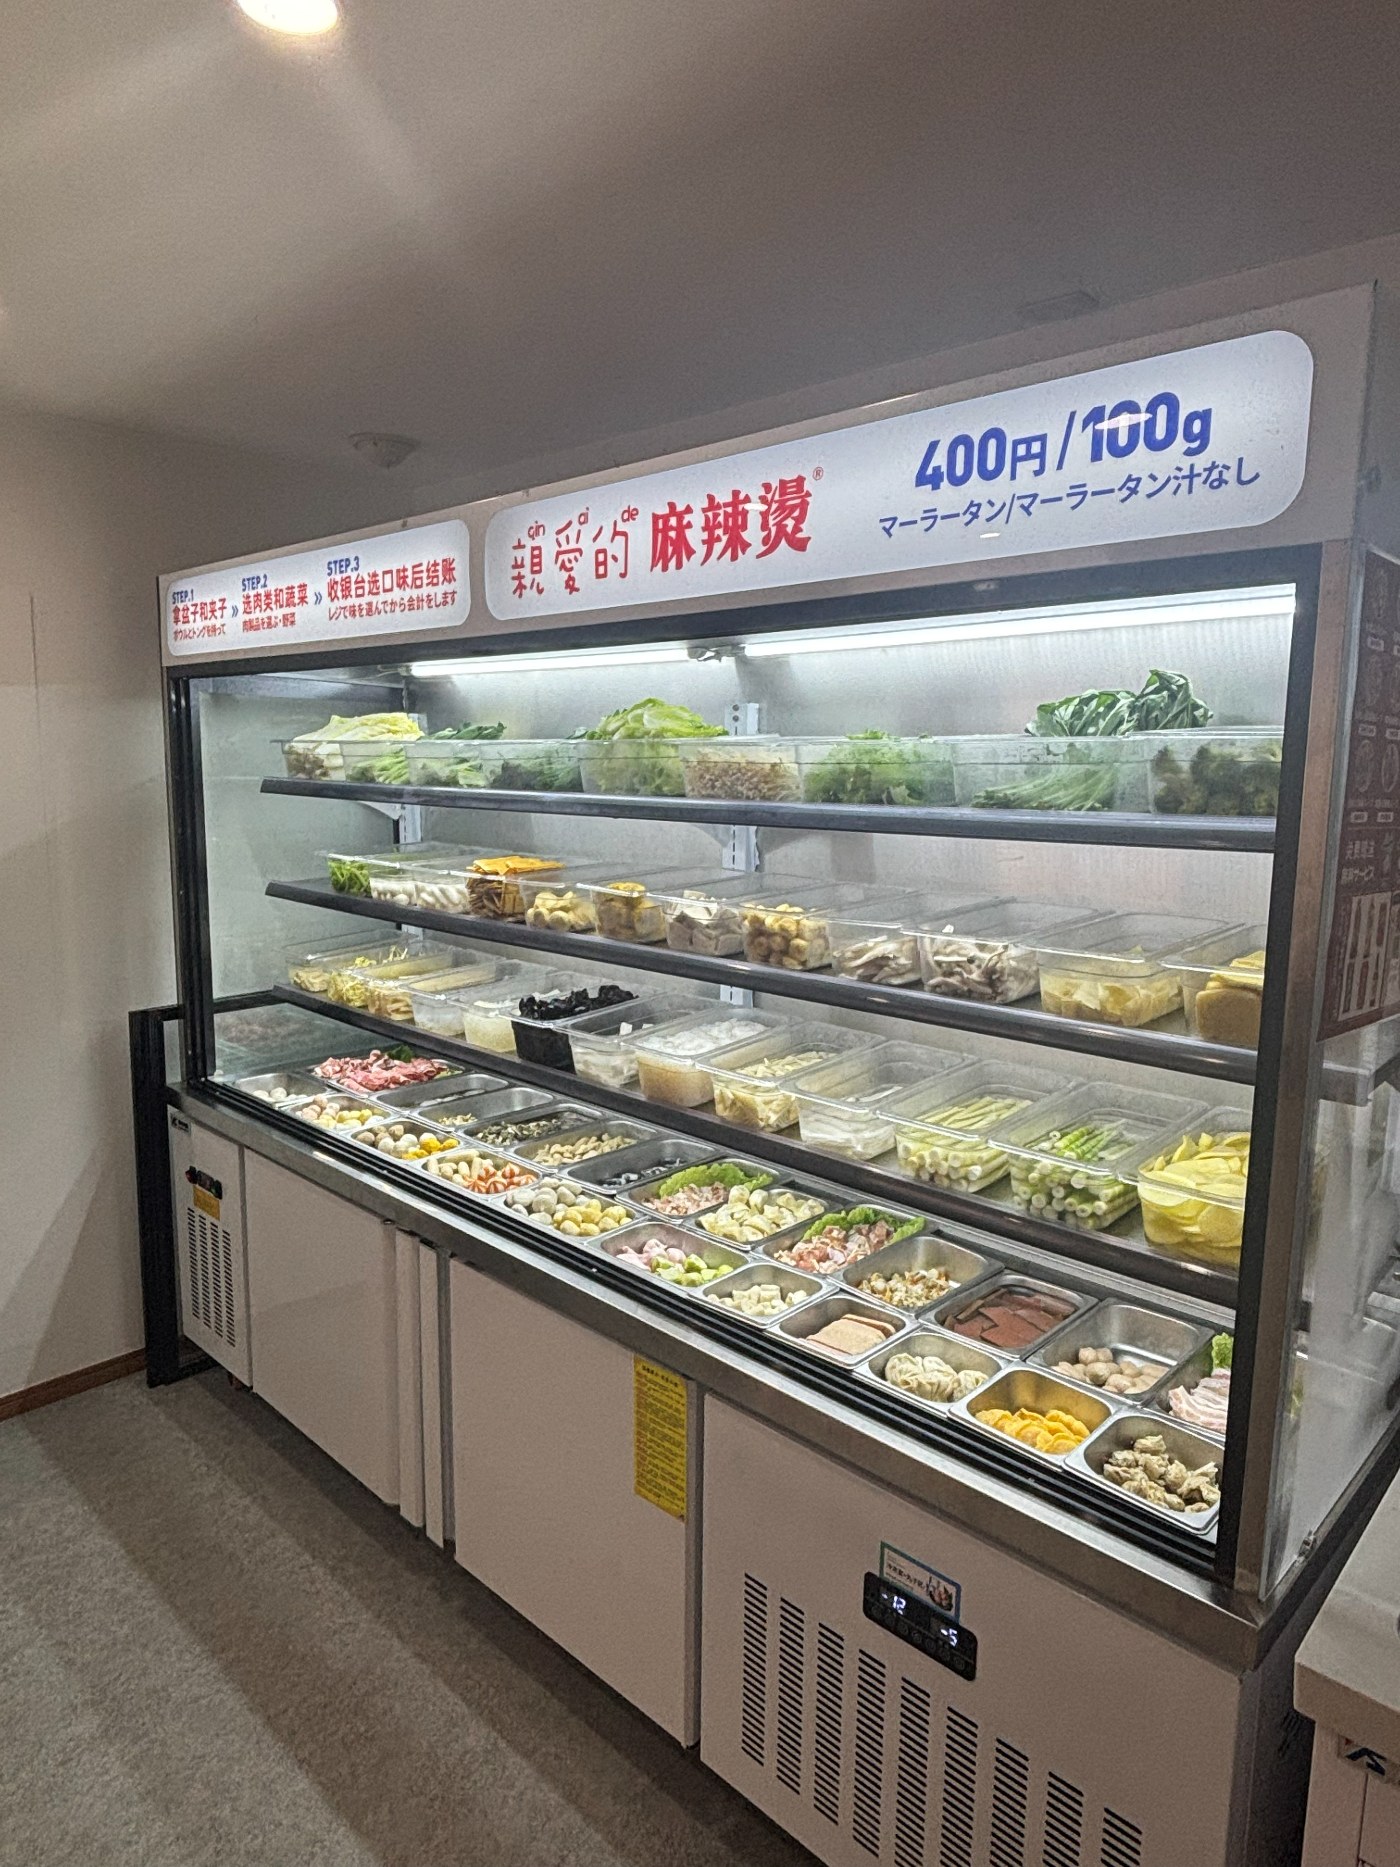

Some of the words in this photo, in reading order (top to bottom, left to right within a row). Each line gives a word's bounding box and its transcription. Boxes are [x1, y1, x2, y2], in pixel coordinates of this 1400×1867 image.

[621, 505, 639, 524] de
[327, 556, 360, 576] STEP.3
[241, 574, 268, 592] STEP.2
[327, 557, 457, 603] 收银台选口味后结账
[172, 589, 194, 605] STEP.1
[242, 582, 309, 615] 选肉类和蔬菜
